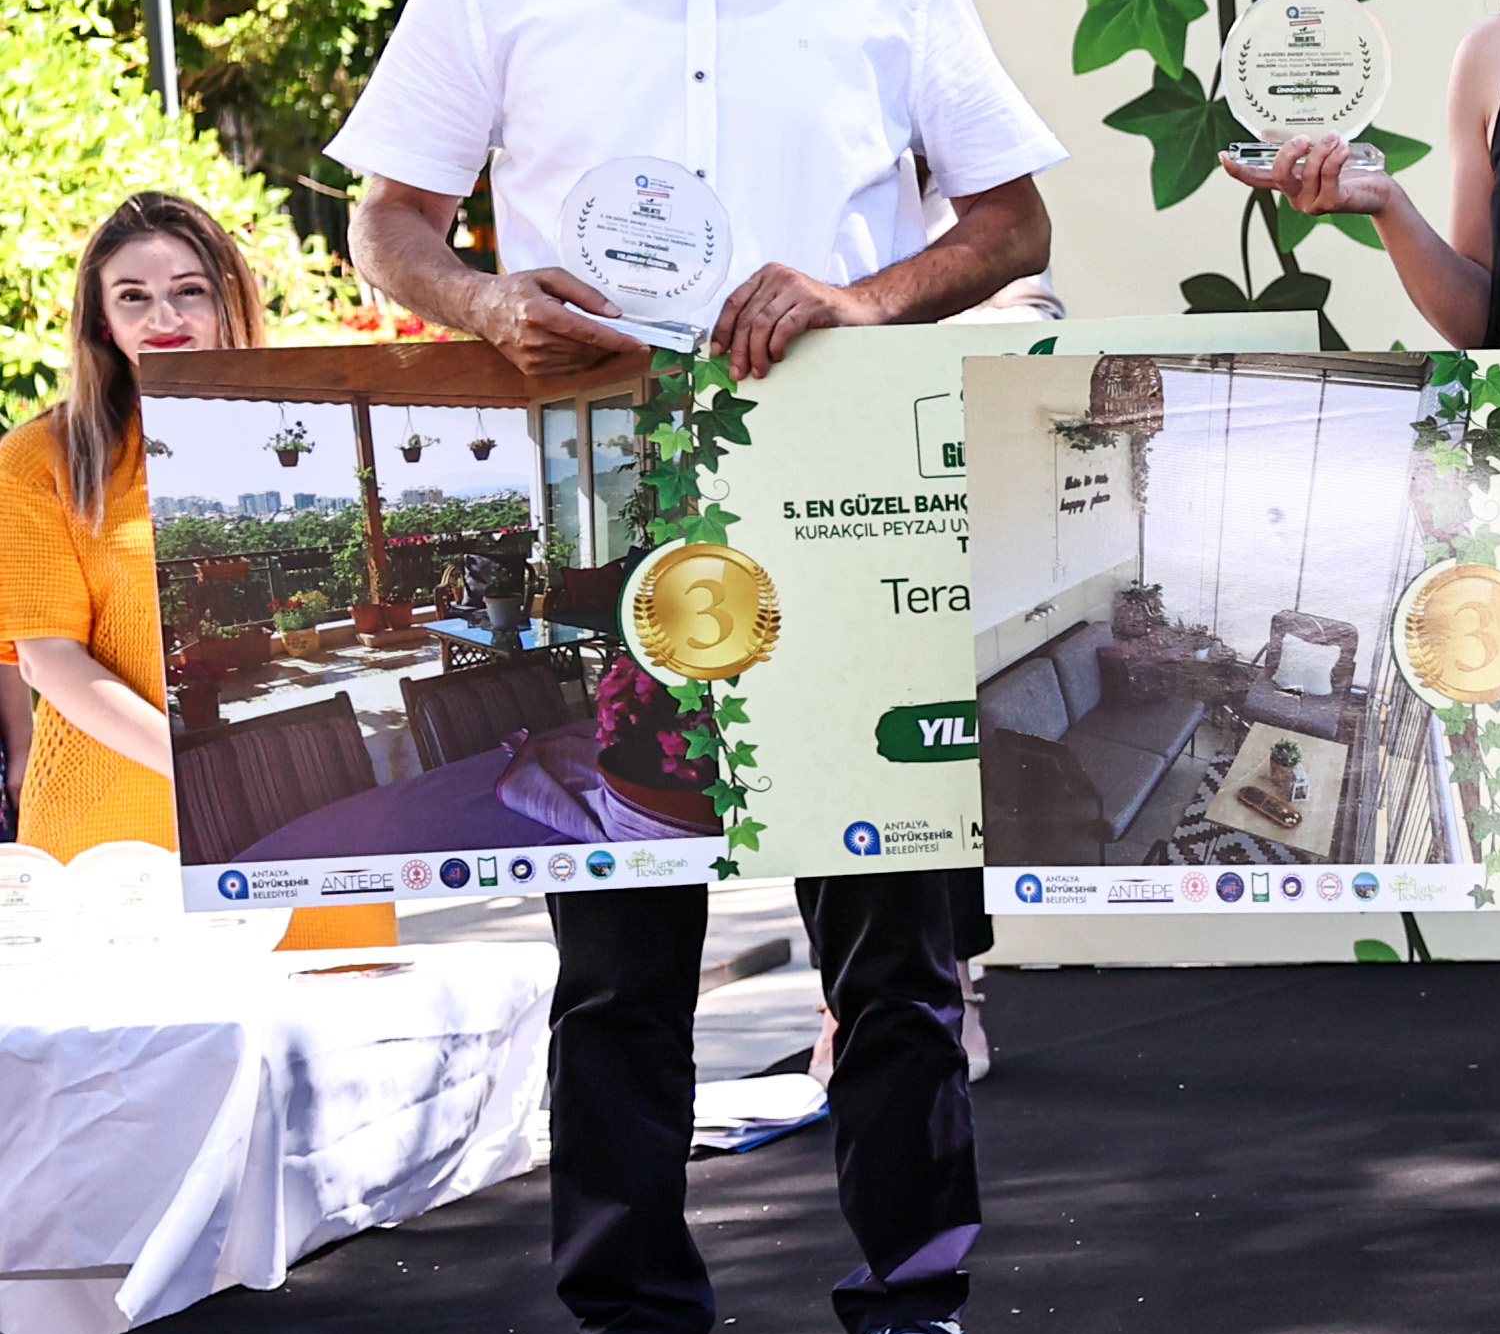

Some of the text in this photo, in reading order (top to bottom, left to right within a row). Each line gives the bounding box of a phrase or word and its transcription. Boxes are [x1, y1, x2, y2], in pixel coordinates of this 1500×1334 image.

[783, 502, 800, 519] 5.
[806, 499, 835, 518] EN
[840, 493, 910, 516] GÜZEL
[795, 519, 945, 540] KURAKÇIL PEYZAJ
[880, 577, 971, 614] Tera
[884, 820, 929, 830] ANTALYA
[885, 828, 953, 844] BÜYÜKŞEHİR
[885, 842, 939, 855] BELEDİYESİ
[321, 869, 395, 890] ANTEPE
[1108, 884, 1173, 899] ANTEPE
